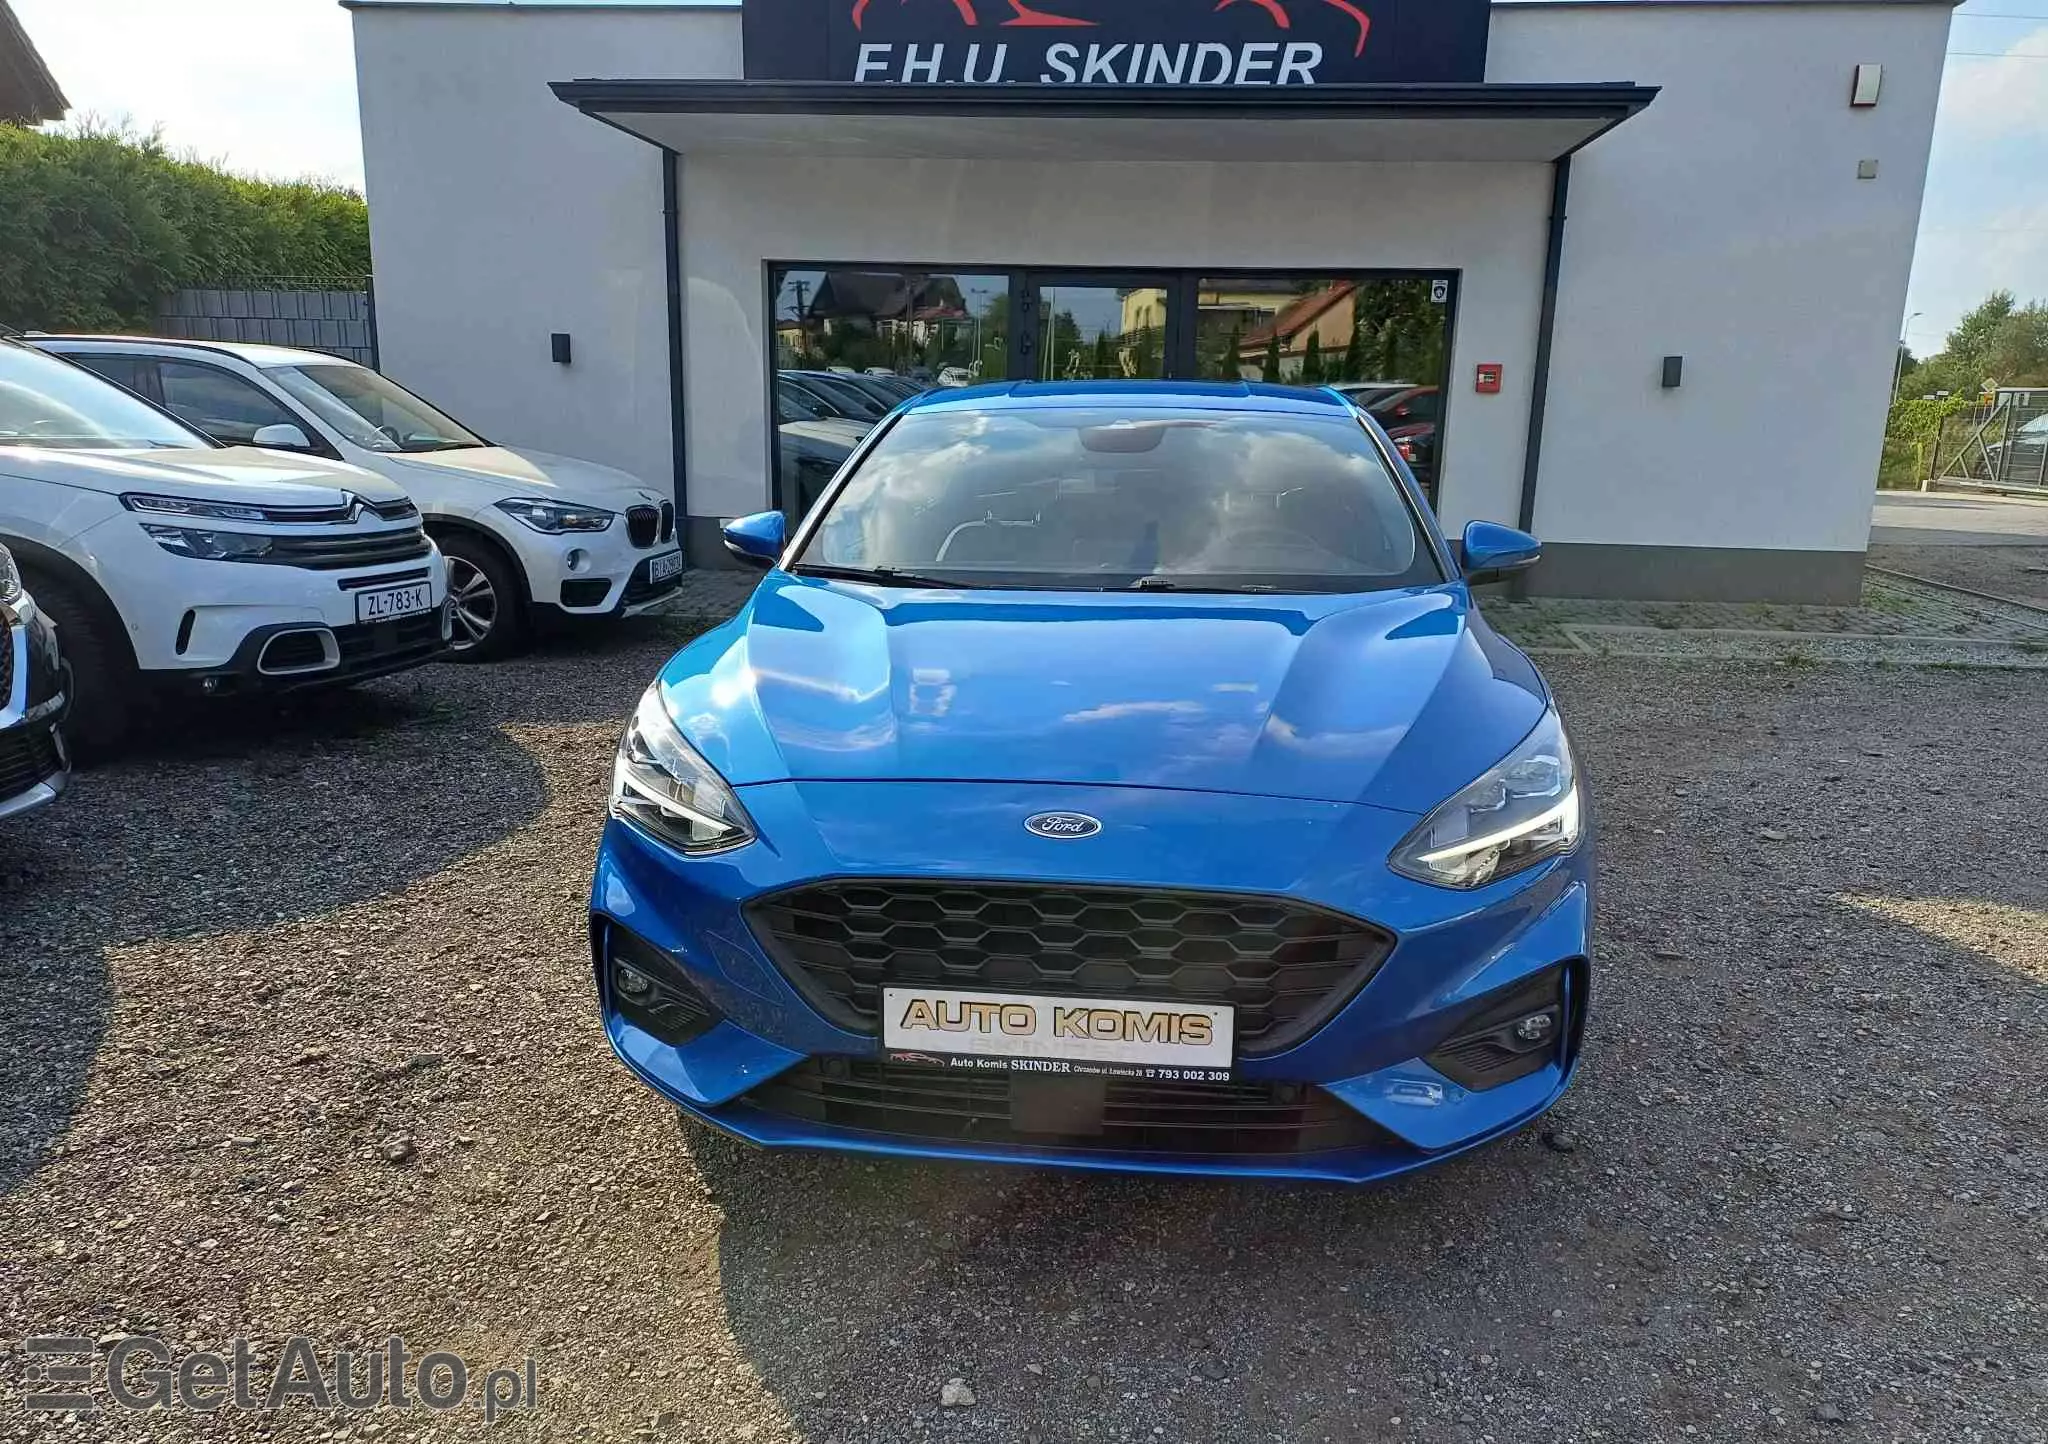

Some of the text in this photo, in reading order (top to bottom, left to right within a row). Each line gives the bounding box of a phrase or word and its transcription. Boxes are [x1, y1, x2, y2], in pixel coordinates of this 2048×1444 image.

[854, 41, 1323, 84] F.H.U. SKINDER
[367, 588, 423, 616] ZL-783-K
[1041, 816, 1085, 832] Ford
[900, 998, 1214, 1046] AUTO KOMIS
[950, 1057, 974, 1068] Auto
[976, 1059, 1008, 1070] Komis
[1011, 1059, 1071, 1073] SKINDER
[1158, 1069, 1180, 1079] 793
[1183, 1070, 1205, 1081] 002
[1208, 1071, 1230, 1082] 309
